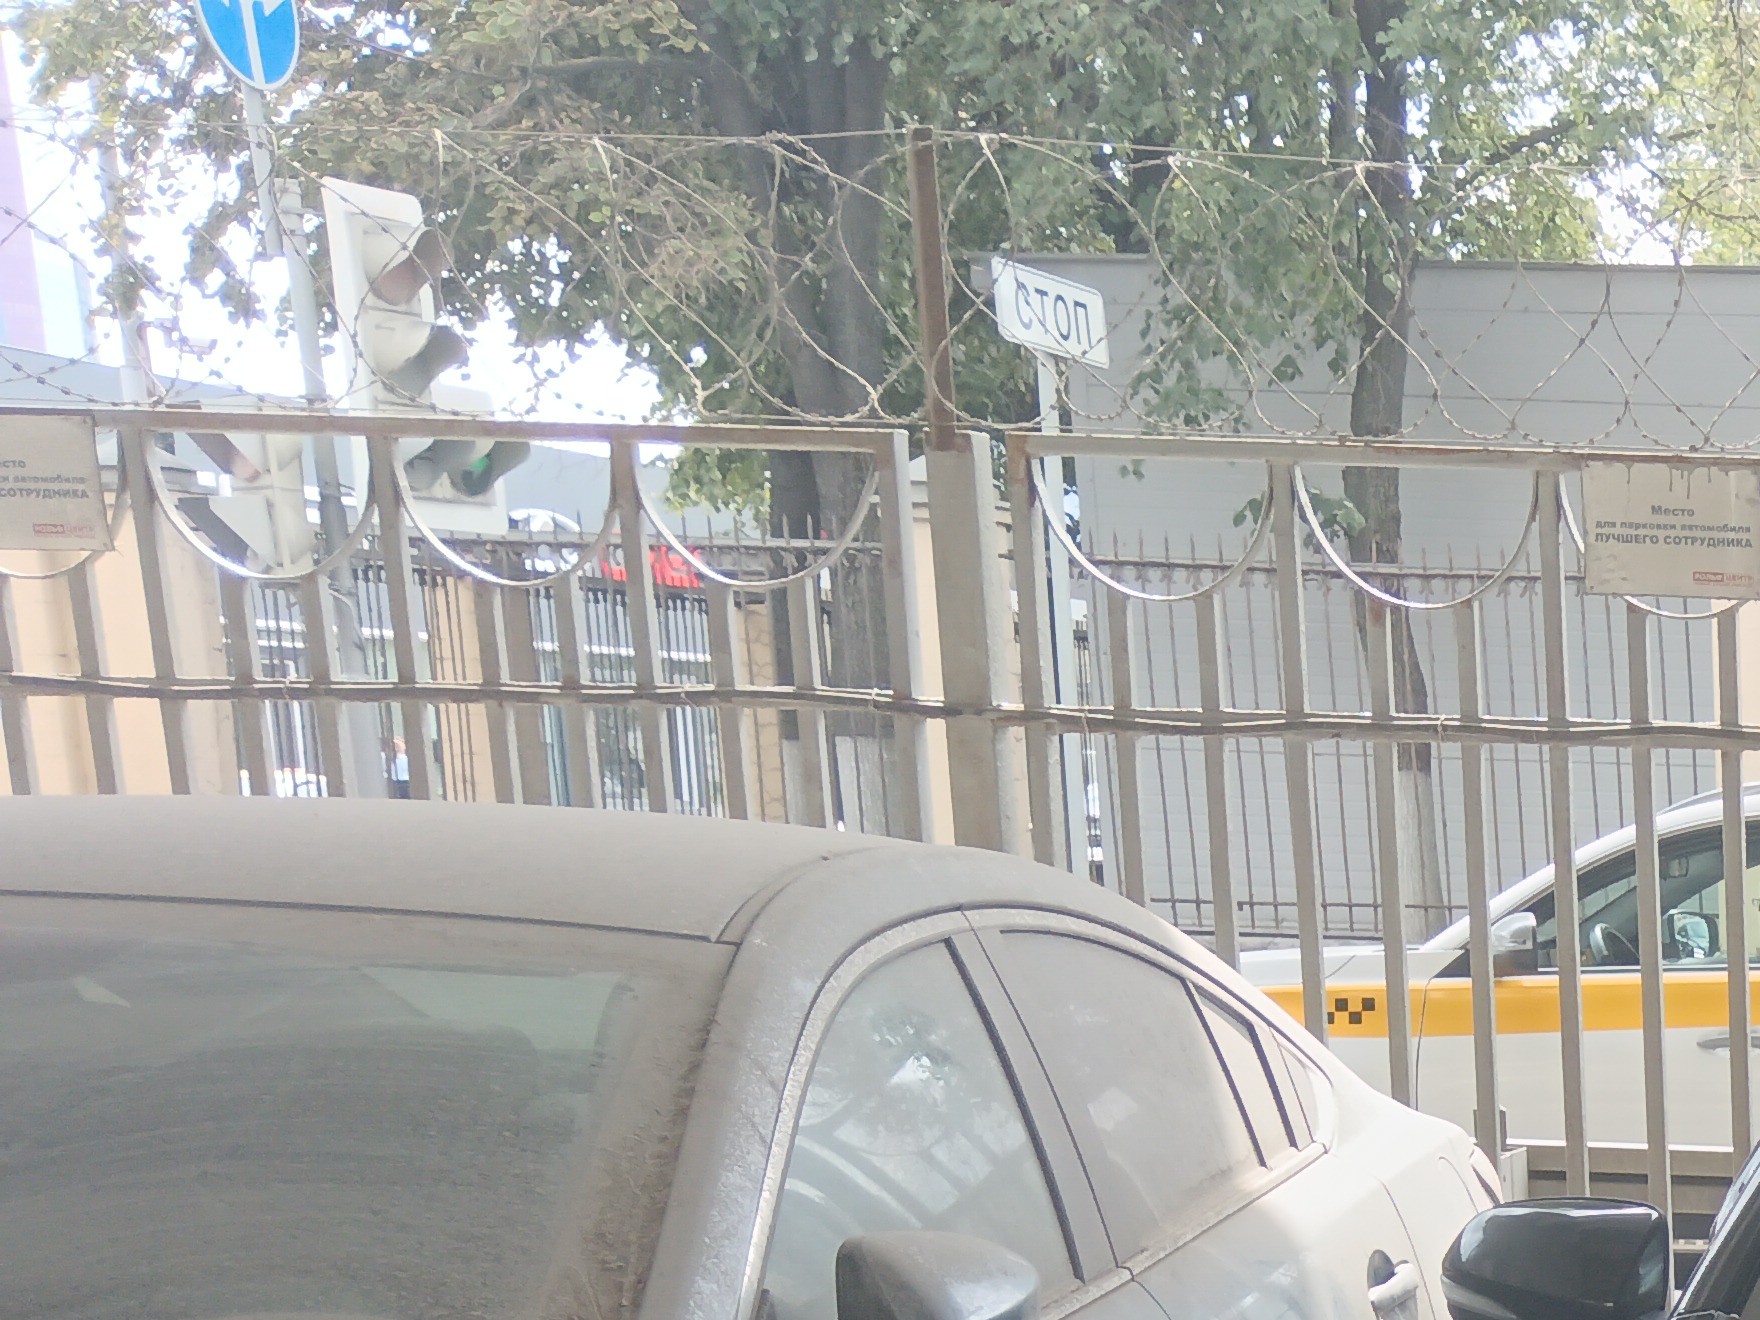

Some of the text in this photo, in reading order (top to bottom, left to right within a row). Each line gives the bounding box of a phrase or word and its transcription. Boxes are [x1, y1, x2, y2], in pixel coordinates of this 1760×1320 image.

[1014, 281, 1092, 349] СТОП
[0, 459, 26, 469] сто
[1651, 504, 1695, 517] Место
[1595, 520, 1751, 534] для парковки автомобиля
[1594, 532, 1753, 549] ЛУЧШЕГО СОТРУДНИКА
